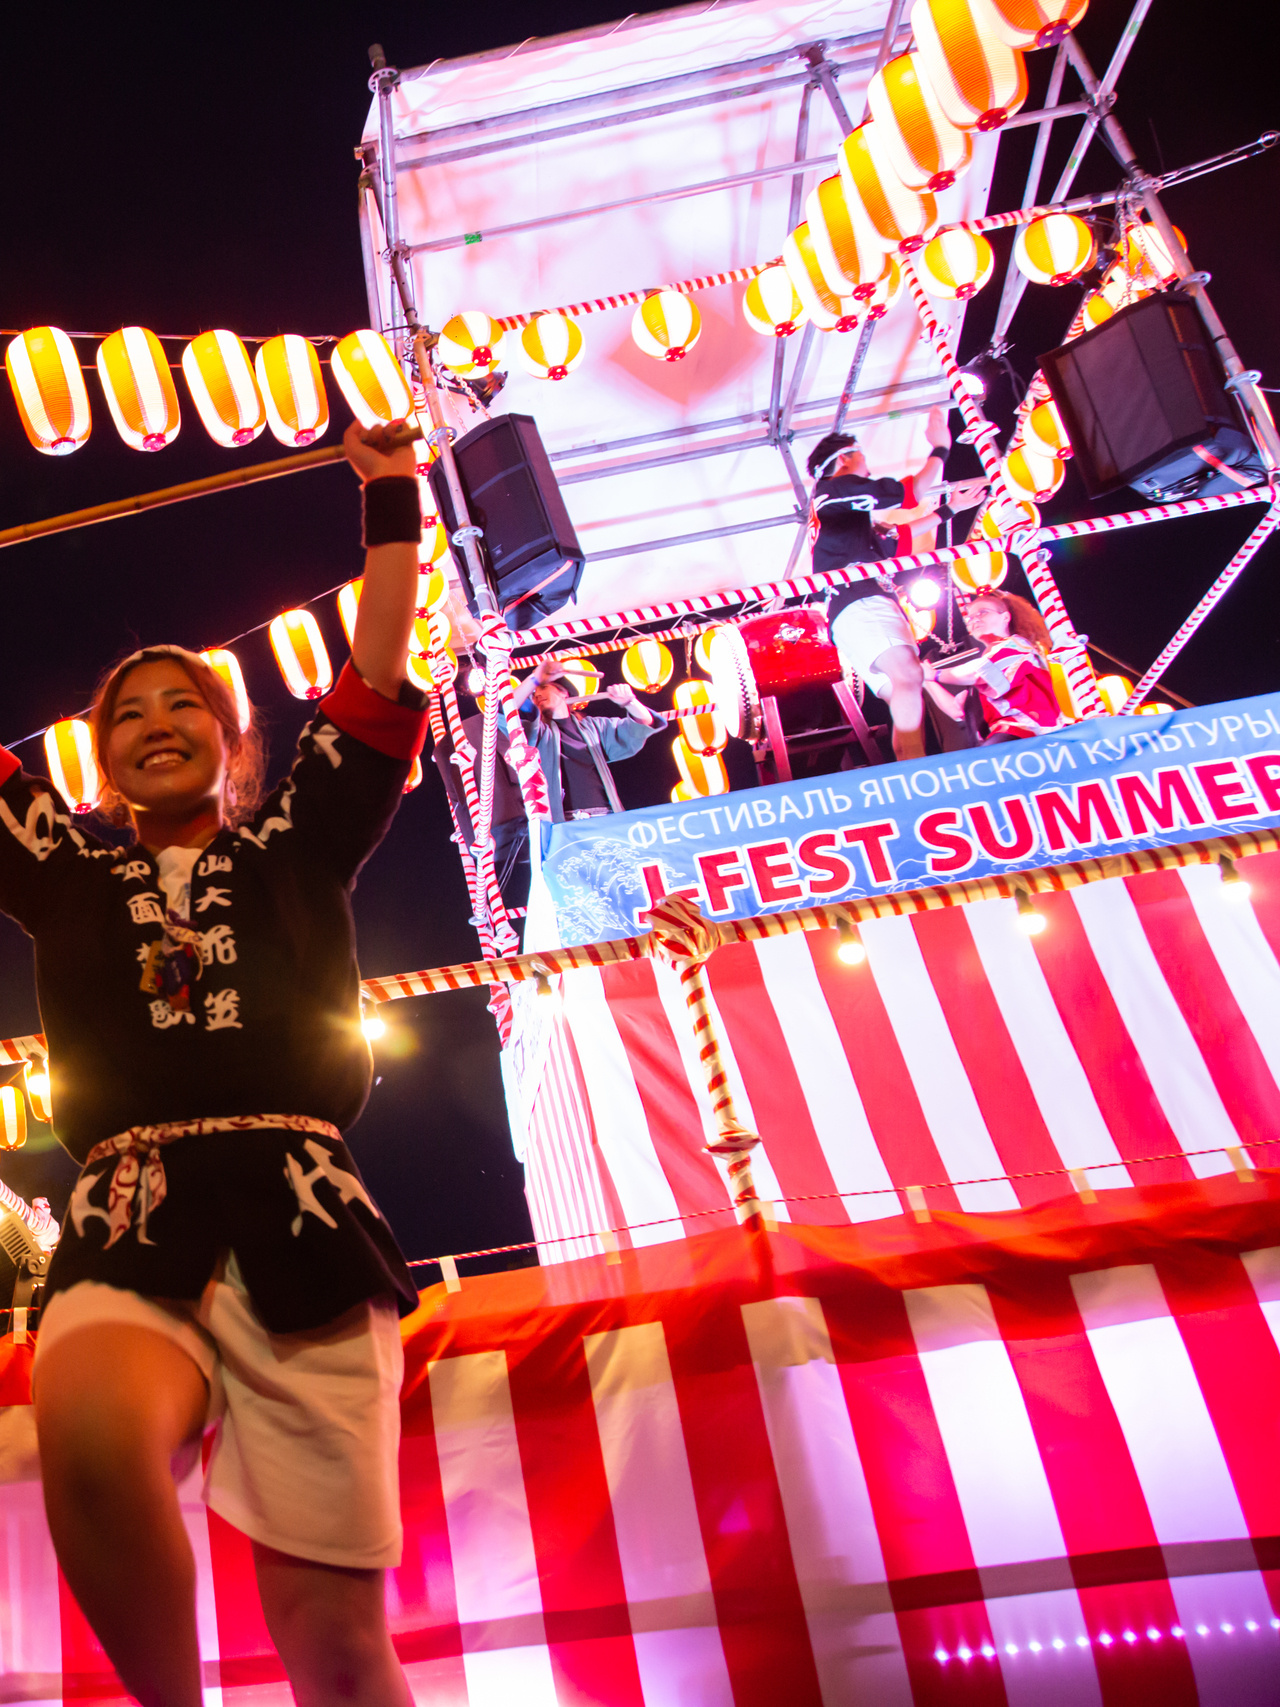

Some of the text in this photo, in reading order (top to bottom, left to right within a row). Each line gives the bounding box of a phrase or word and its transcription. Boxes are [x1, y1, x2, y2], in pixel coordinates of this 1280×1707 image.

[627, 709, 1280, 848] ФЕСТИВАЛЬ ЯПОНСКОЙ КУЛЬТУРЫ
[637, 820, 898, 927] J-FEST
